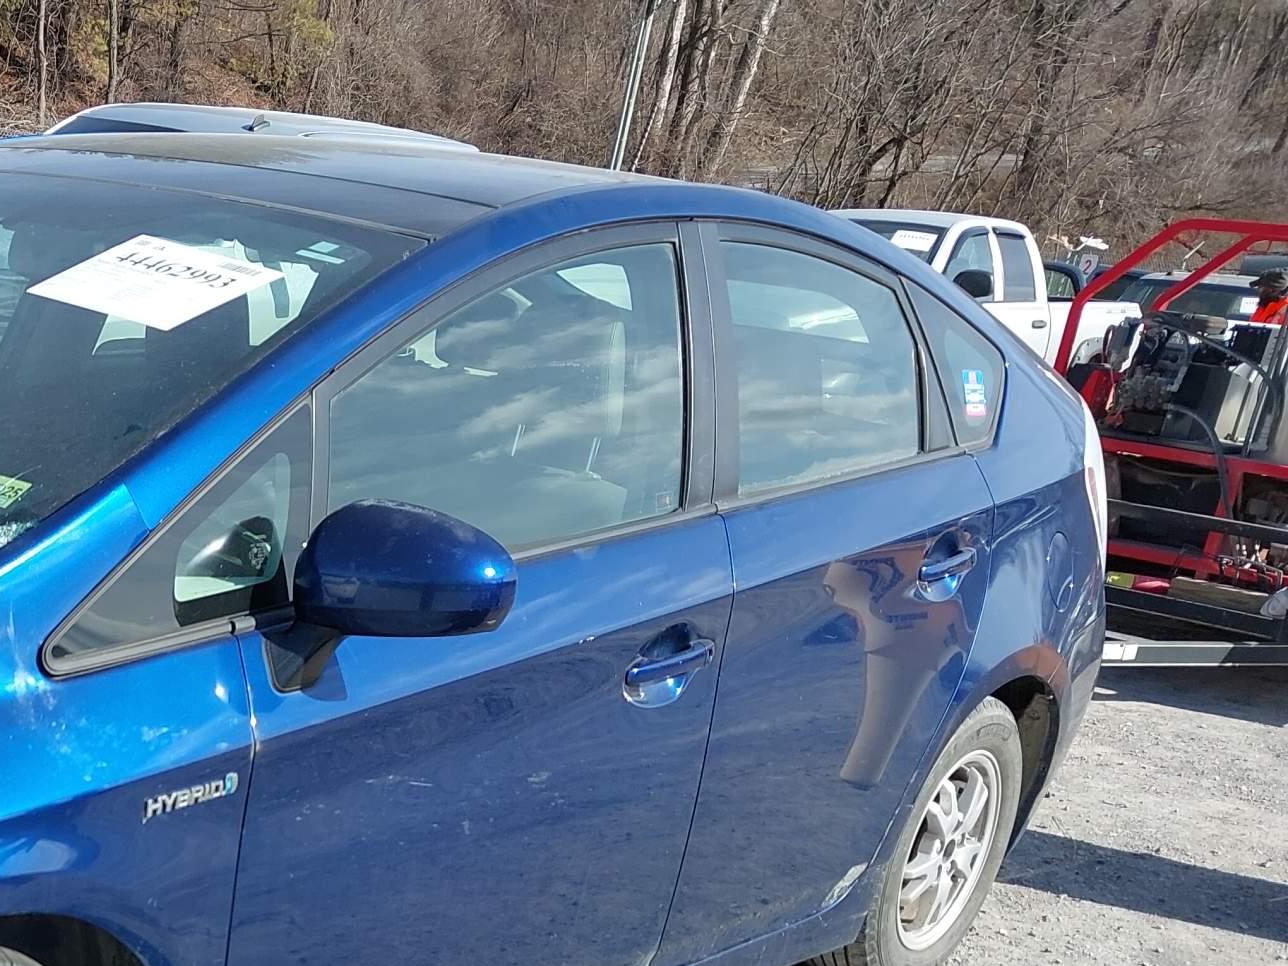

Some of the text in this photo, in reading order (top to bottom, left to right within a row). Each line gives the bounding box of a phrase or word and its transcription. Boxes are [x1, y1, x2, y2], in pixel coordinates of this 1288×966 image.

[115, 252, 237, 288] 44462993
[1083, 260, 1092, 275] 2
[0, 486, 23, 498] 25
[144, 779, 224, 818] HYBRID
